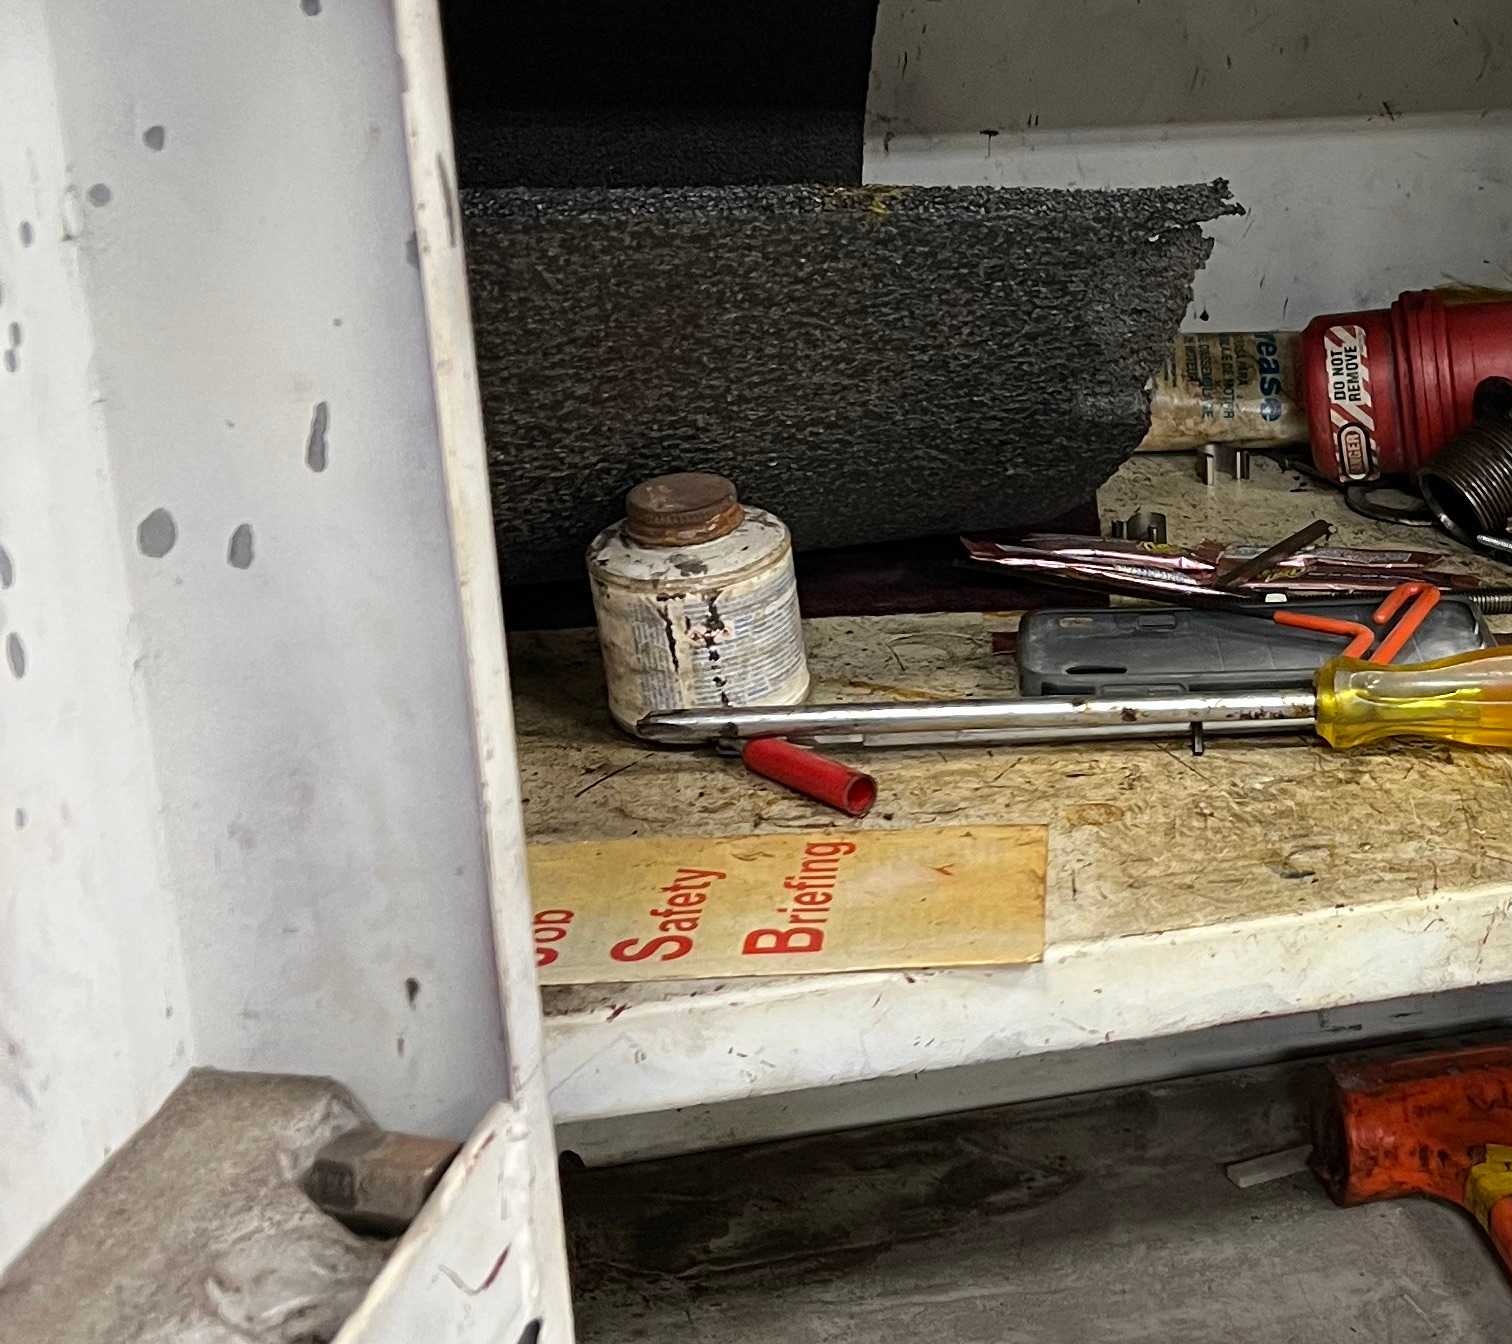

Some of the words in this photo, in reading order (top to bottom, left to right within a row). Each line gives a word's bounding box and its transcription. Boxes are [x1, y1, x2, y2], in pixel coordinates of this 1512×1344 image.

[1254, 333, 1282, 422] rease
[1330, 350, 1346, 379] NOT
[1333, 380, 1347, 401] DO
[1343, 346, 1362, 402] REMOVE
[610, 868, 727, 963] Safety
[741, 841, 857, 956] Briefing
[532, 909, 575, 968] ob
